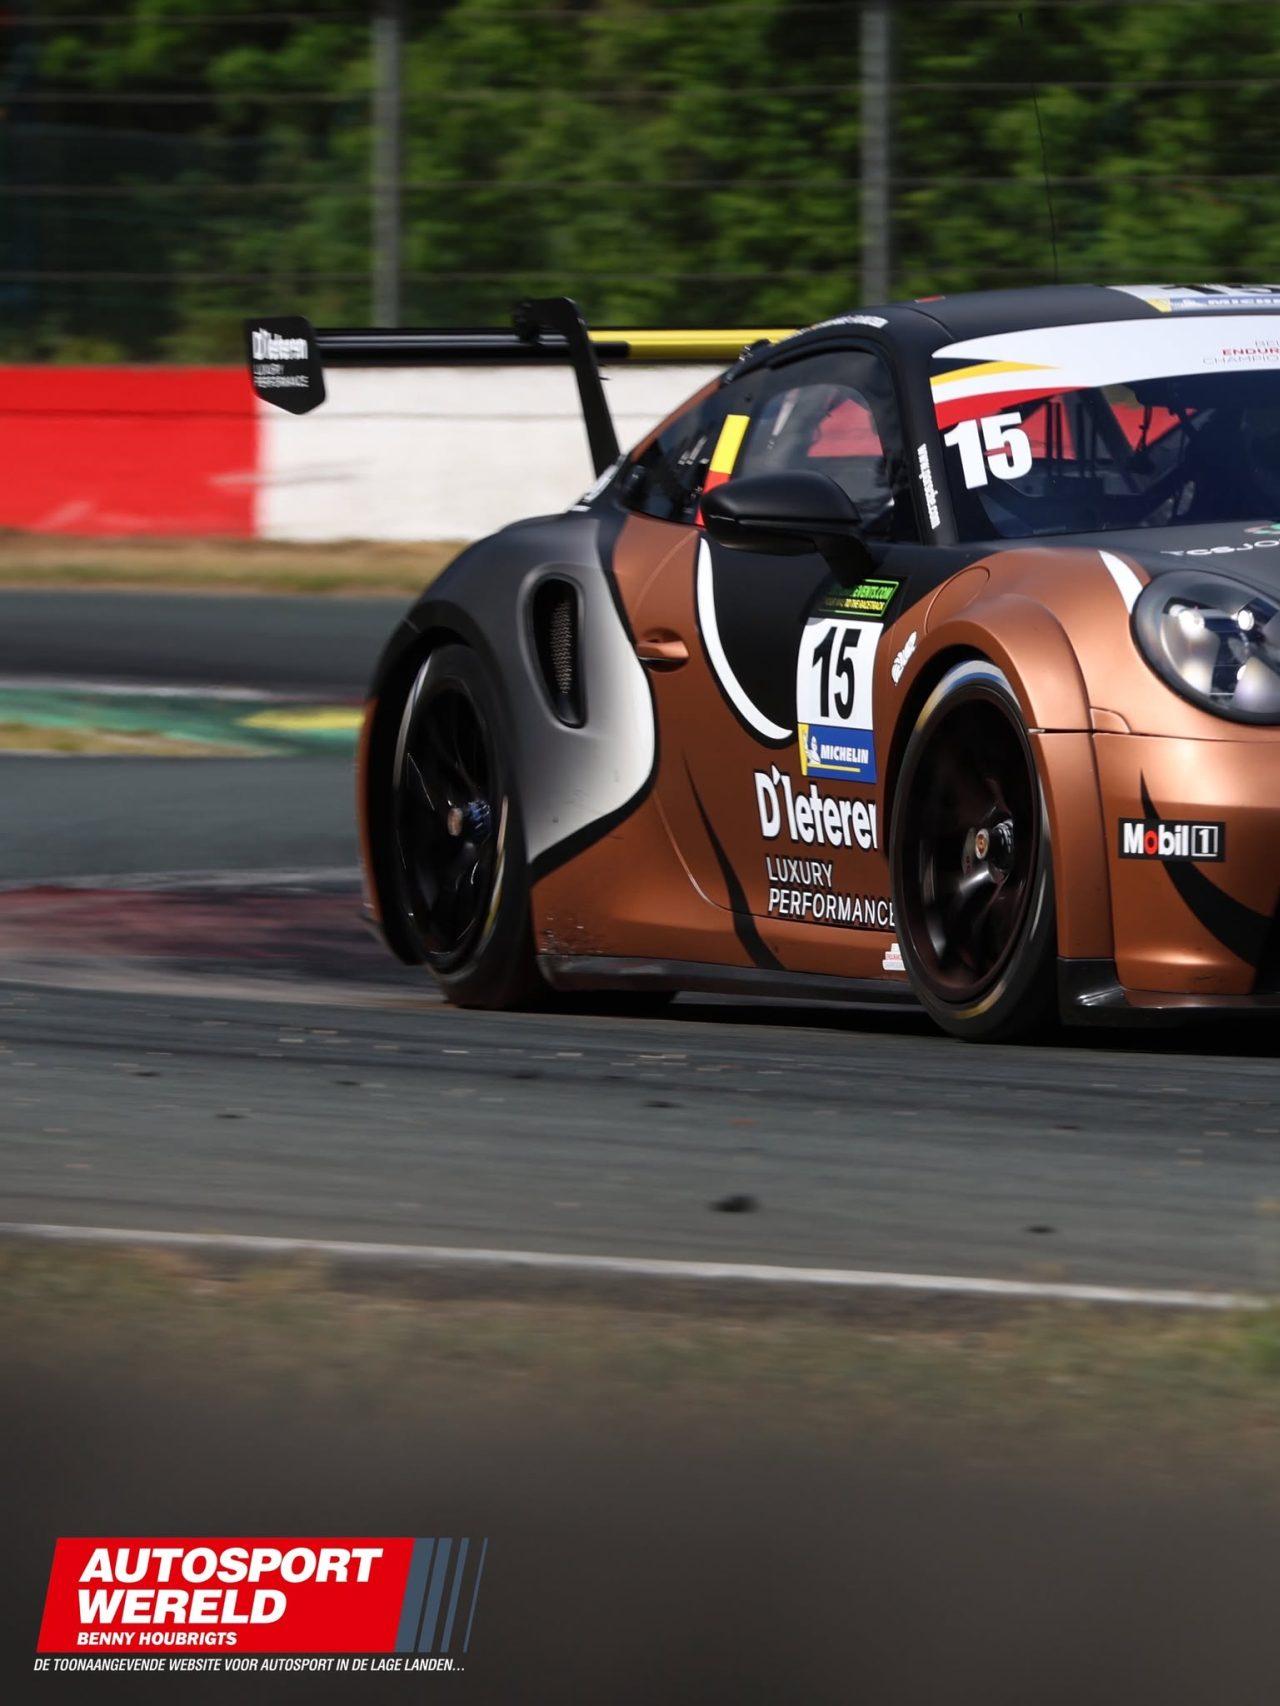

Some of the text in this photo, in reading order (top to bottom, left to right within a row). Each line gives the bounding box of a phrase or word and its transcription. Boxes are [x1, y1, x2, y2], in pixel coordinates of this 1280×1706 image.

[943, 411, 1033, 490] 15
[812, 626, 862, 720] 15
[820, 744, 869, 764] MICHELIN
[1123, 822, 1190, 856] Mobil
[766, 856, 833, 888] LUXURY
